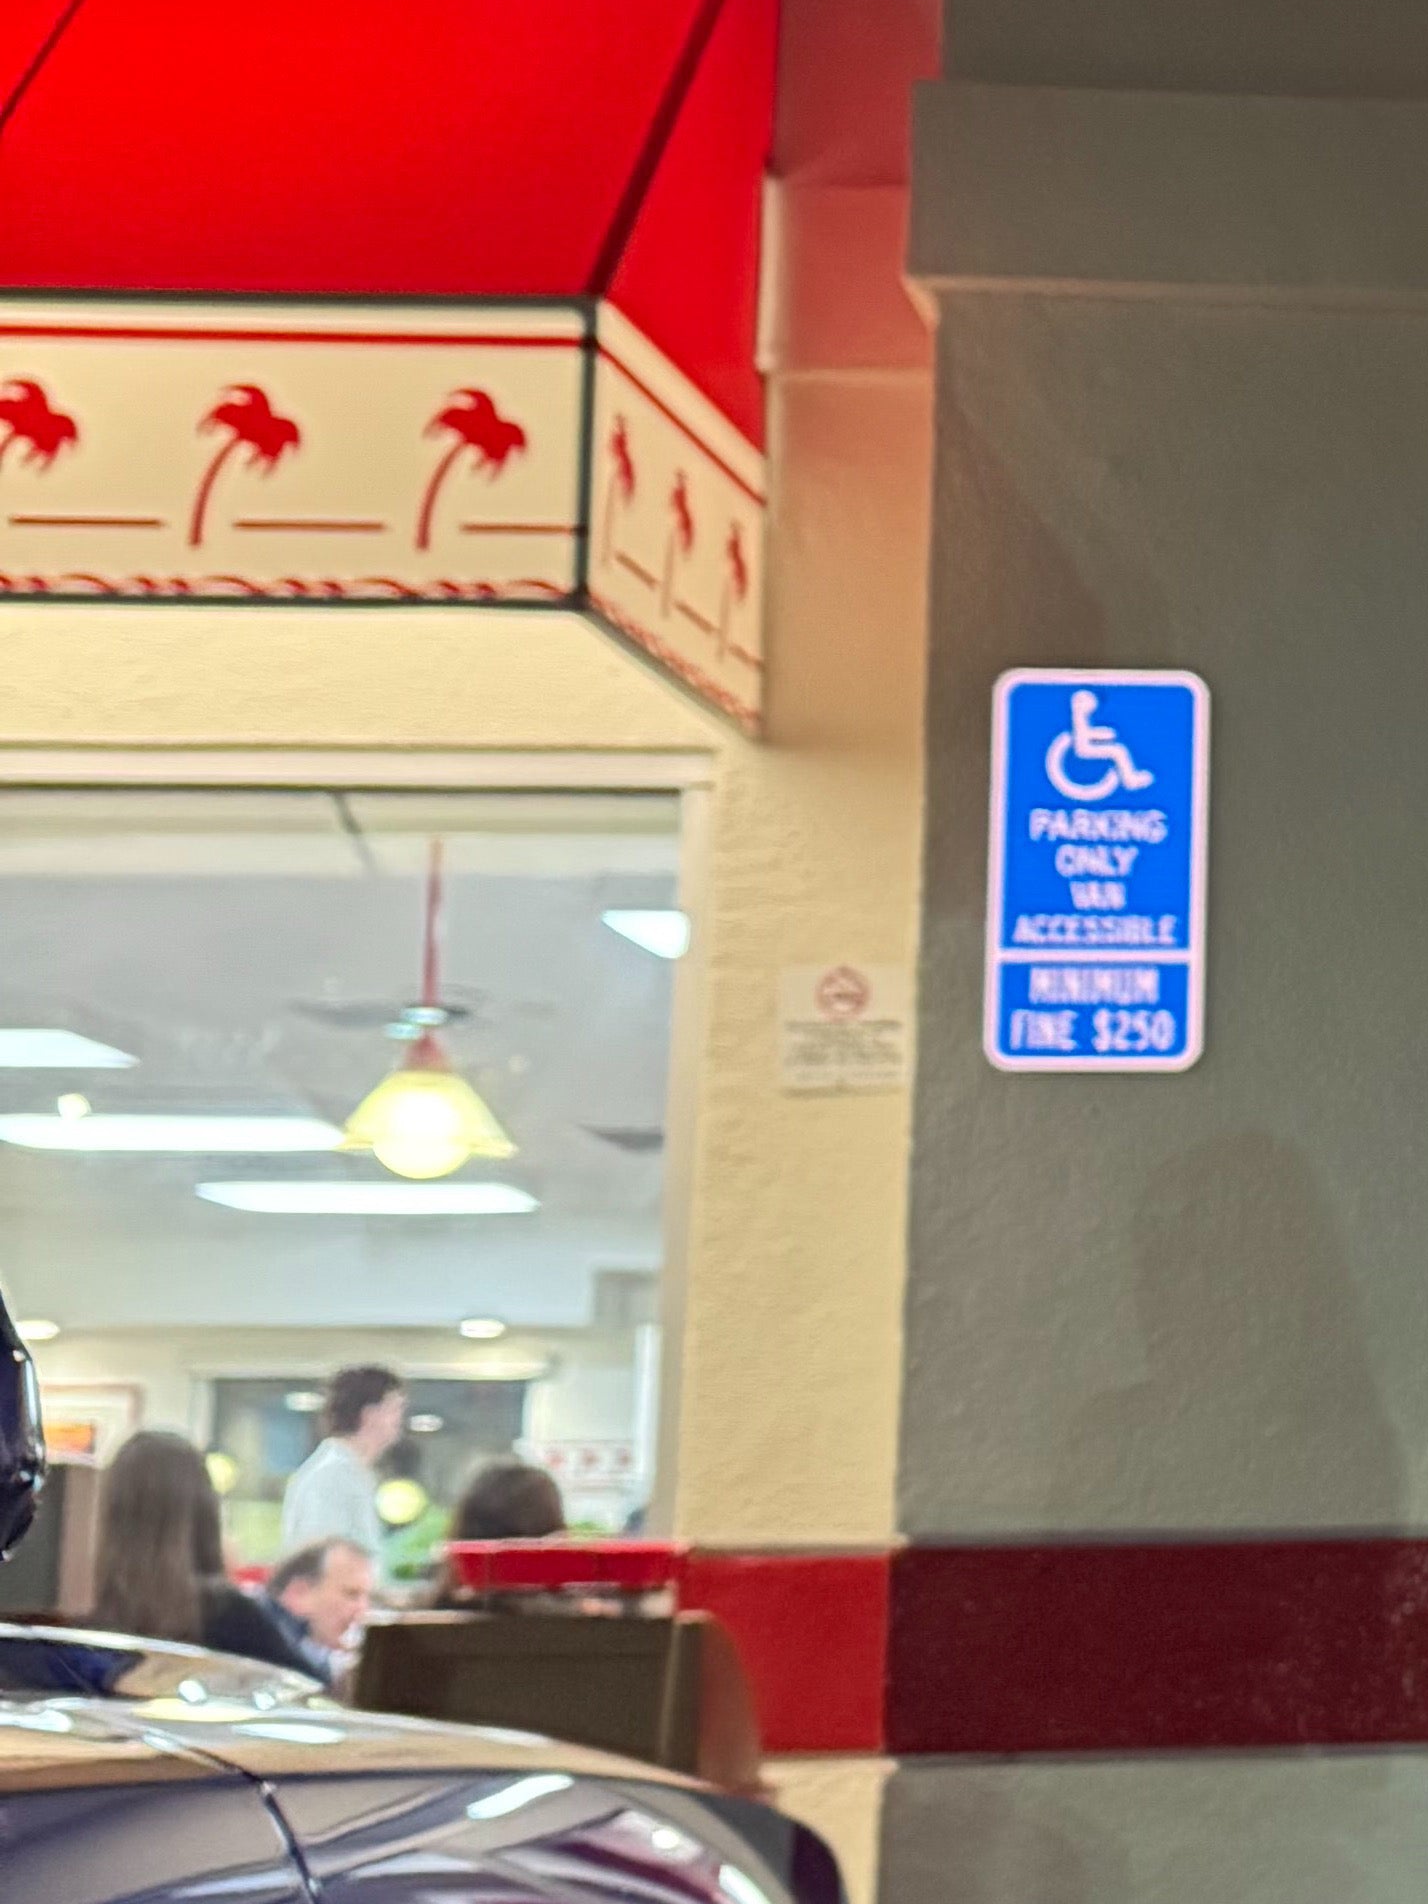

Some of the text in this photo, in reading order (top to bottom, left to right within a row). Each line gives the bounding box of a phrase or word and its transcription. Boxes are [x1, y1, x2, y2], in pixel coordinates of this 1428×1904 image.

[1028, 808, 1168, 844] PARKING
[1055, 844, 1139, 877] ONLY
[1069, 881, 1127, 910] VAN
[1012, 914, 1178, 945] ACCESSIBLE
[1029, 968, 1160, 1005] MINIMUM
[1010, 1009, 1175, 1051] FINE $250
